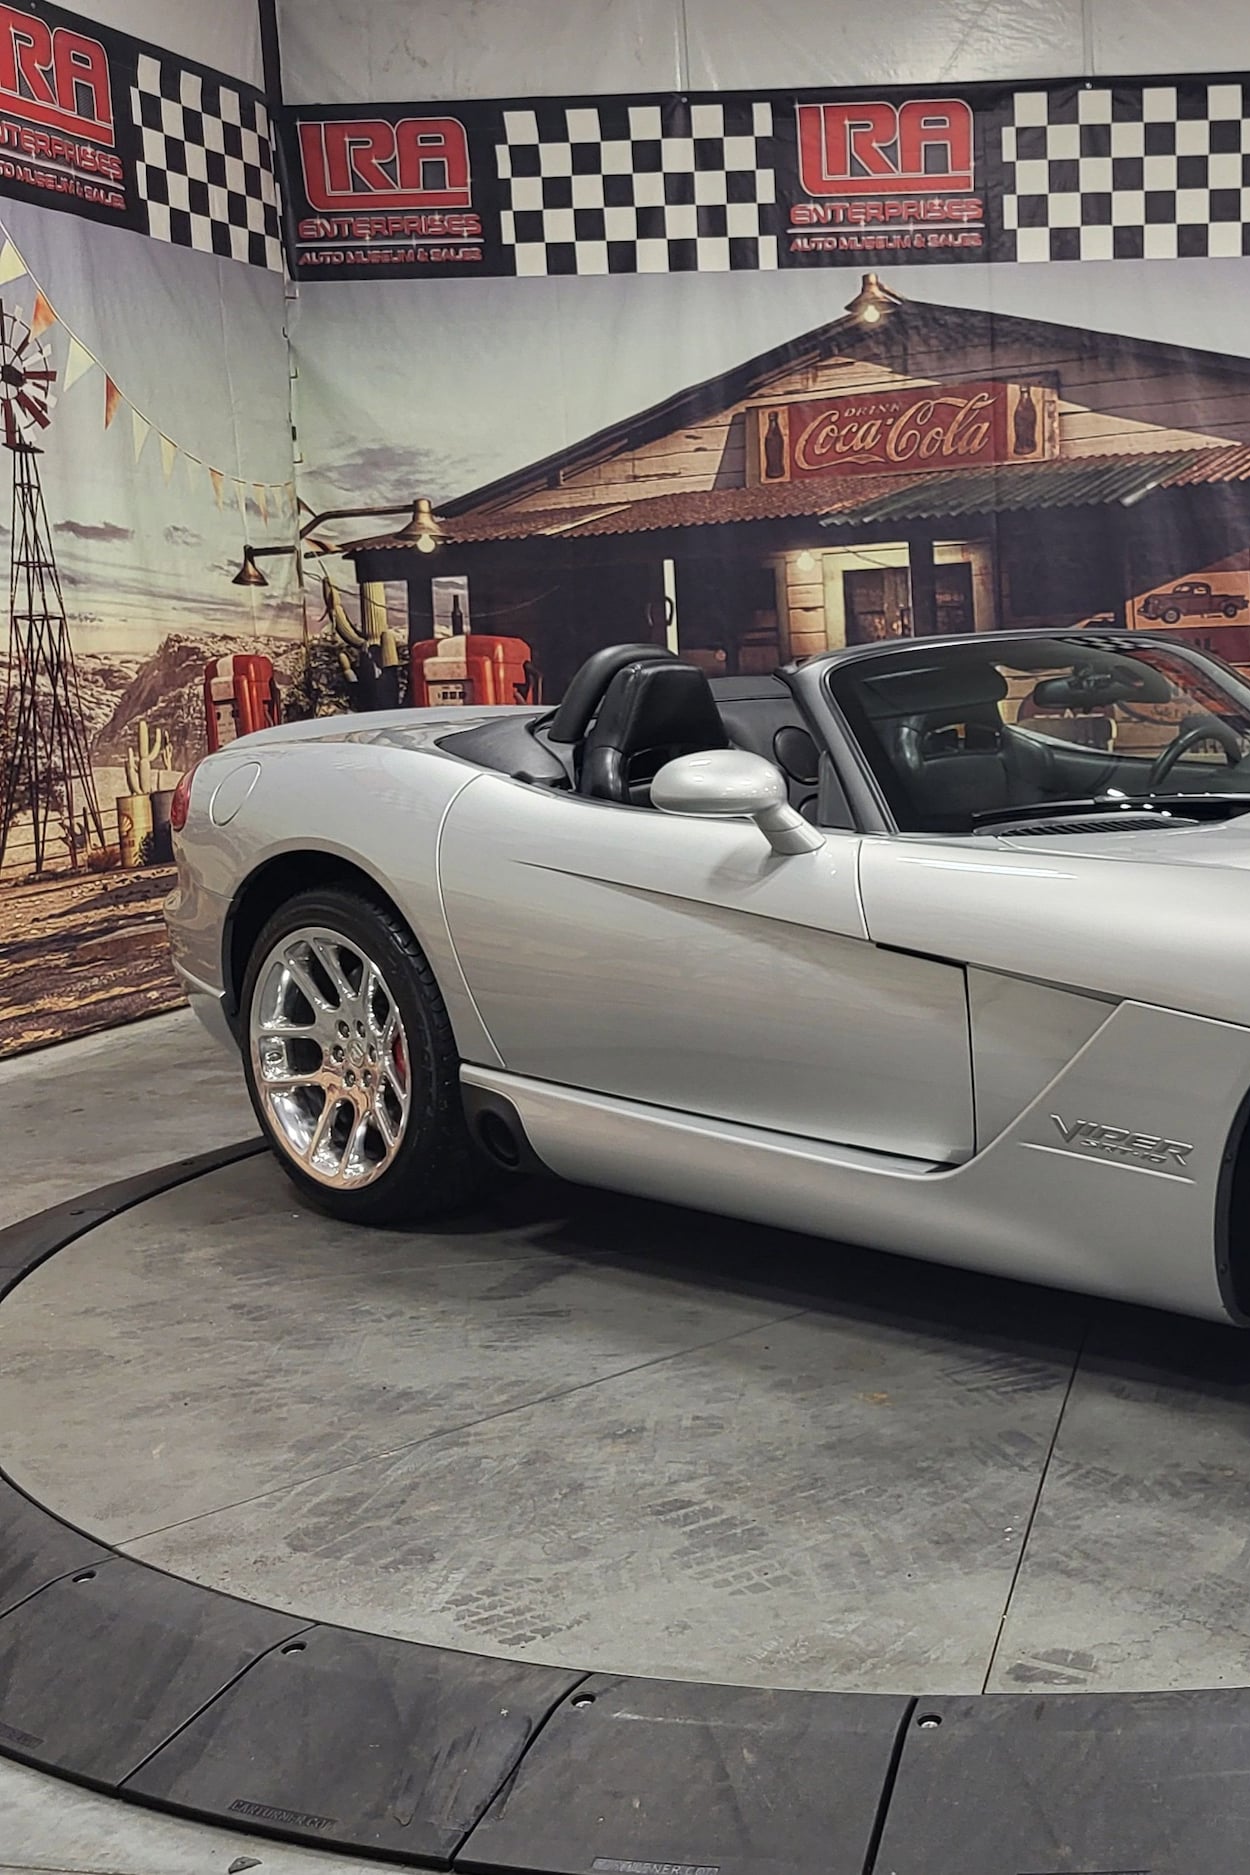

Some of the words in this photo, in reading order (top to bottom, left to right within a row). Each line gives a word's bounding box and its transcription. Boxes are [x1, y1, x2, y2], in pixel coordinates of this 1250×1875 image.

[0, 3, 115, 148] RA
[0, 120, 123, 180] TERPRISES
[297, 116, 472, 212] LRA
[795, 97, 975, 197] LRA
[298, 214, 482, 239] ENTERPRISES
[790, 198, 984, 225] ENTERPRISES
[298, 250, 345, 265] AUTO
[346, 248, 415, 264] MUSEUM
[417, 248, 429, 262] &
[430, 247, 482, 262] SALES
[790, 236, 837, 251] AUTO
[838, 234, 912, 250] MUSEUM
[913, 234, 925, 249] &
[927, 232, 982, 247] SALES
[844, 403, 902, 418] DRINK
[1050, 1112, 1195, 1166] VIPER
